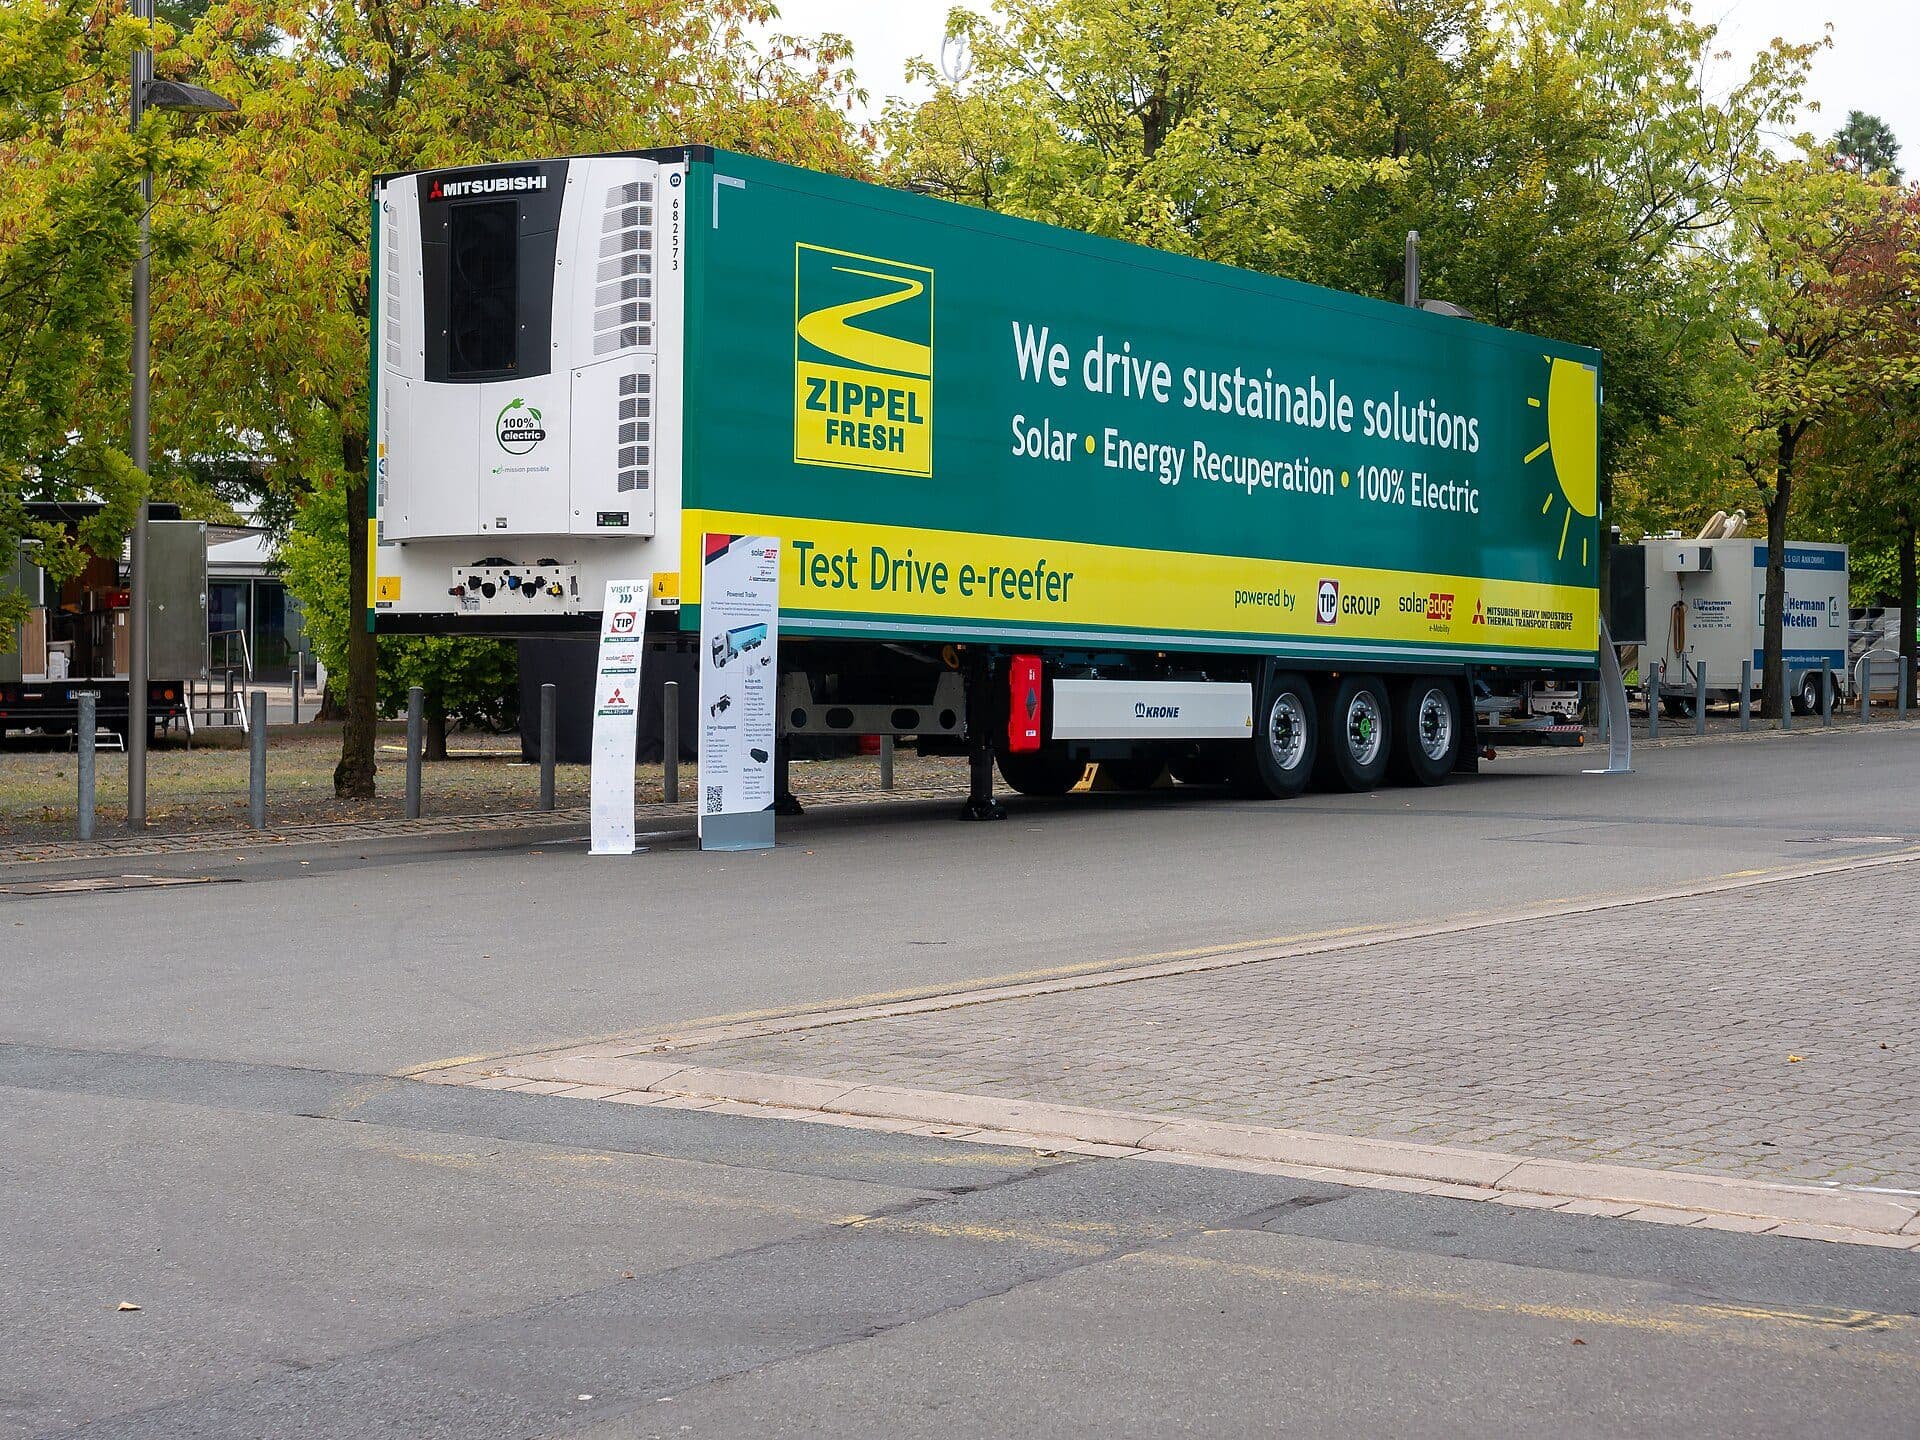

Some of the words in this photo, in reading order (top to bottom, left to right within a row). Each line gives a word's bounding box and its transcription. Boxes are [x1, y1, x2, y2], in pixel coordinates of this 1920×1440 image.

[443, 175, 548, 197] MITSUBISHI
[1012, 321, 1070, 387] We
[1083, 335, 1171, 403] drive
[1183, 366, 1354, 432] sustainable
[1363, 390, 1479, 453] solutions
[806, 376, 924, 424] ZIPPEL
[503, 417, 534, 428] 100%
[504, 431, 541, 440] electric
[826, 419, 904, 453] FRESH
[527, 465, 550, 473] possible
[1012, 414, 1077, 462] Solar
[1104, 427, 1186, 485] Energy
[1193, 440, 1334, 495] Recuperation
[1357, 465, 1405, 504] 100%
[1411, 472, 1479, 514] Electric
[1678, 553, 1684, 564] 1
[792, 540, 858, 589] Test
[871, 546, 948, 595] Drive
[959, 559, 1074, 602] e-reefer
[611, 585, 631, 593] VISIT
[633, 585, 644, 593] US
[658, 581, 664, 592] 4
[1235, 589, 1280, 608] powered
[1284, 589, 1296, 611] by
[1320, 593, 1336, 612] TIP
[1342, 594, 1381, 616] GROUP
[1399, 591, 1455, 620] solaredge
[1789, 598, 1826, 611] Hermann
[1487, 606, 1520, 616] MITSUBISHI
[1521, 608, 1540, 619] HEAVY
[1541, 610, 1573, 621] INDUSTRIES
[1783, 613, 1818, 628] Wecken
[615, 618, 632, 628] TIP
[1429, 623, 1451, 635] e-Mobility
[1487, 616, 1514, 627] THERMAL
[1515, 617, 1549, 629] TRANSPORT
[1550, 620, 1572, 631] EUROPE
[1146, 706, 1180, 718] KRONE
